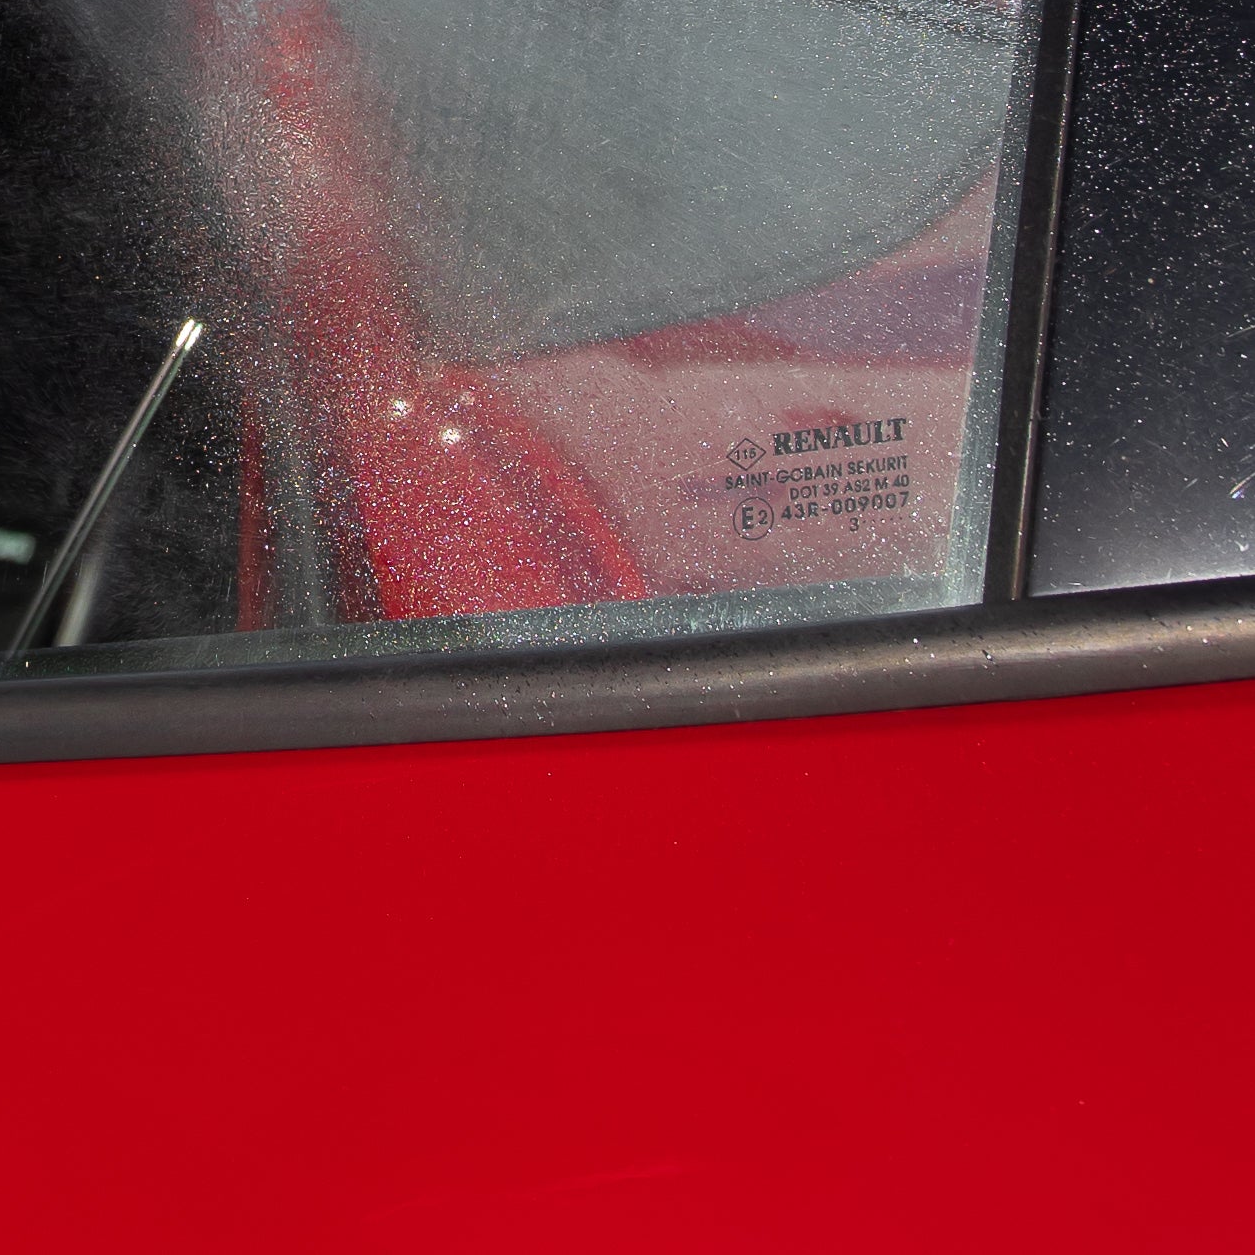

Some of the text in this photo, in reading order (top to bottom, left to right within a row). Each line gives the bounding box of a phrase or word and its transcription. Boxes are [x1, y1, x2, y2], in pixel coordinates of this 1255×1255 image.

[772, 417, 907, 457] RENAULT
[725, 455, 909, 491] SAINT-GOBAIN SEKURIT
[789, 474, 910, 501] DOT 39 AS2 M 40
[780, 490, 910, 520] 43R-009007
[849, 517, 860, 532] 3
